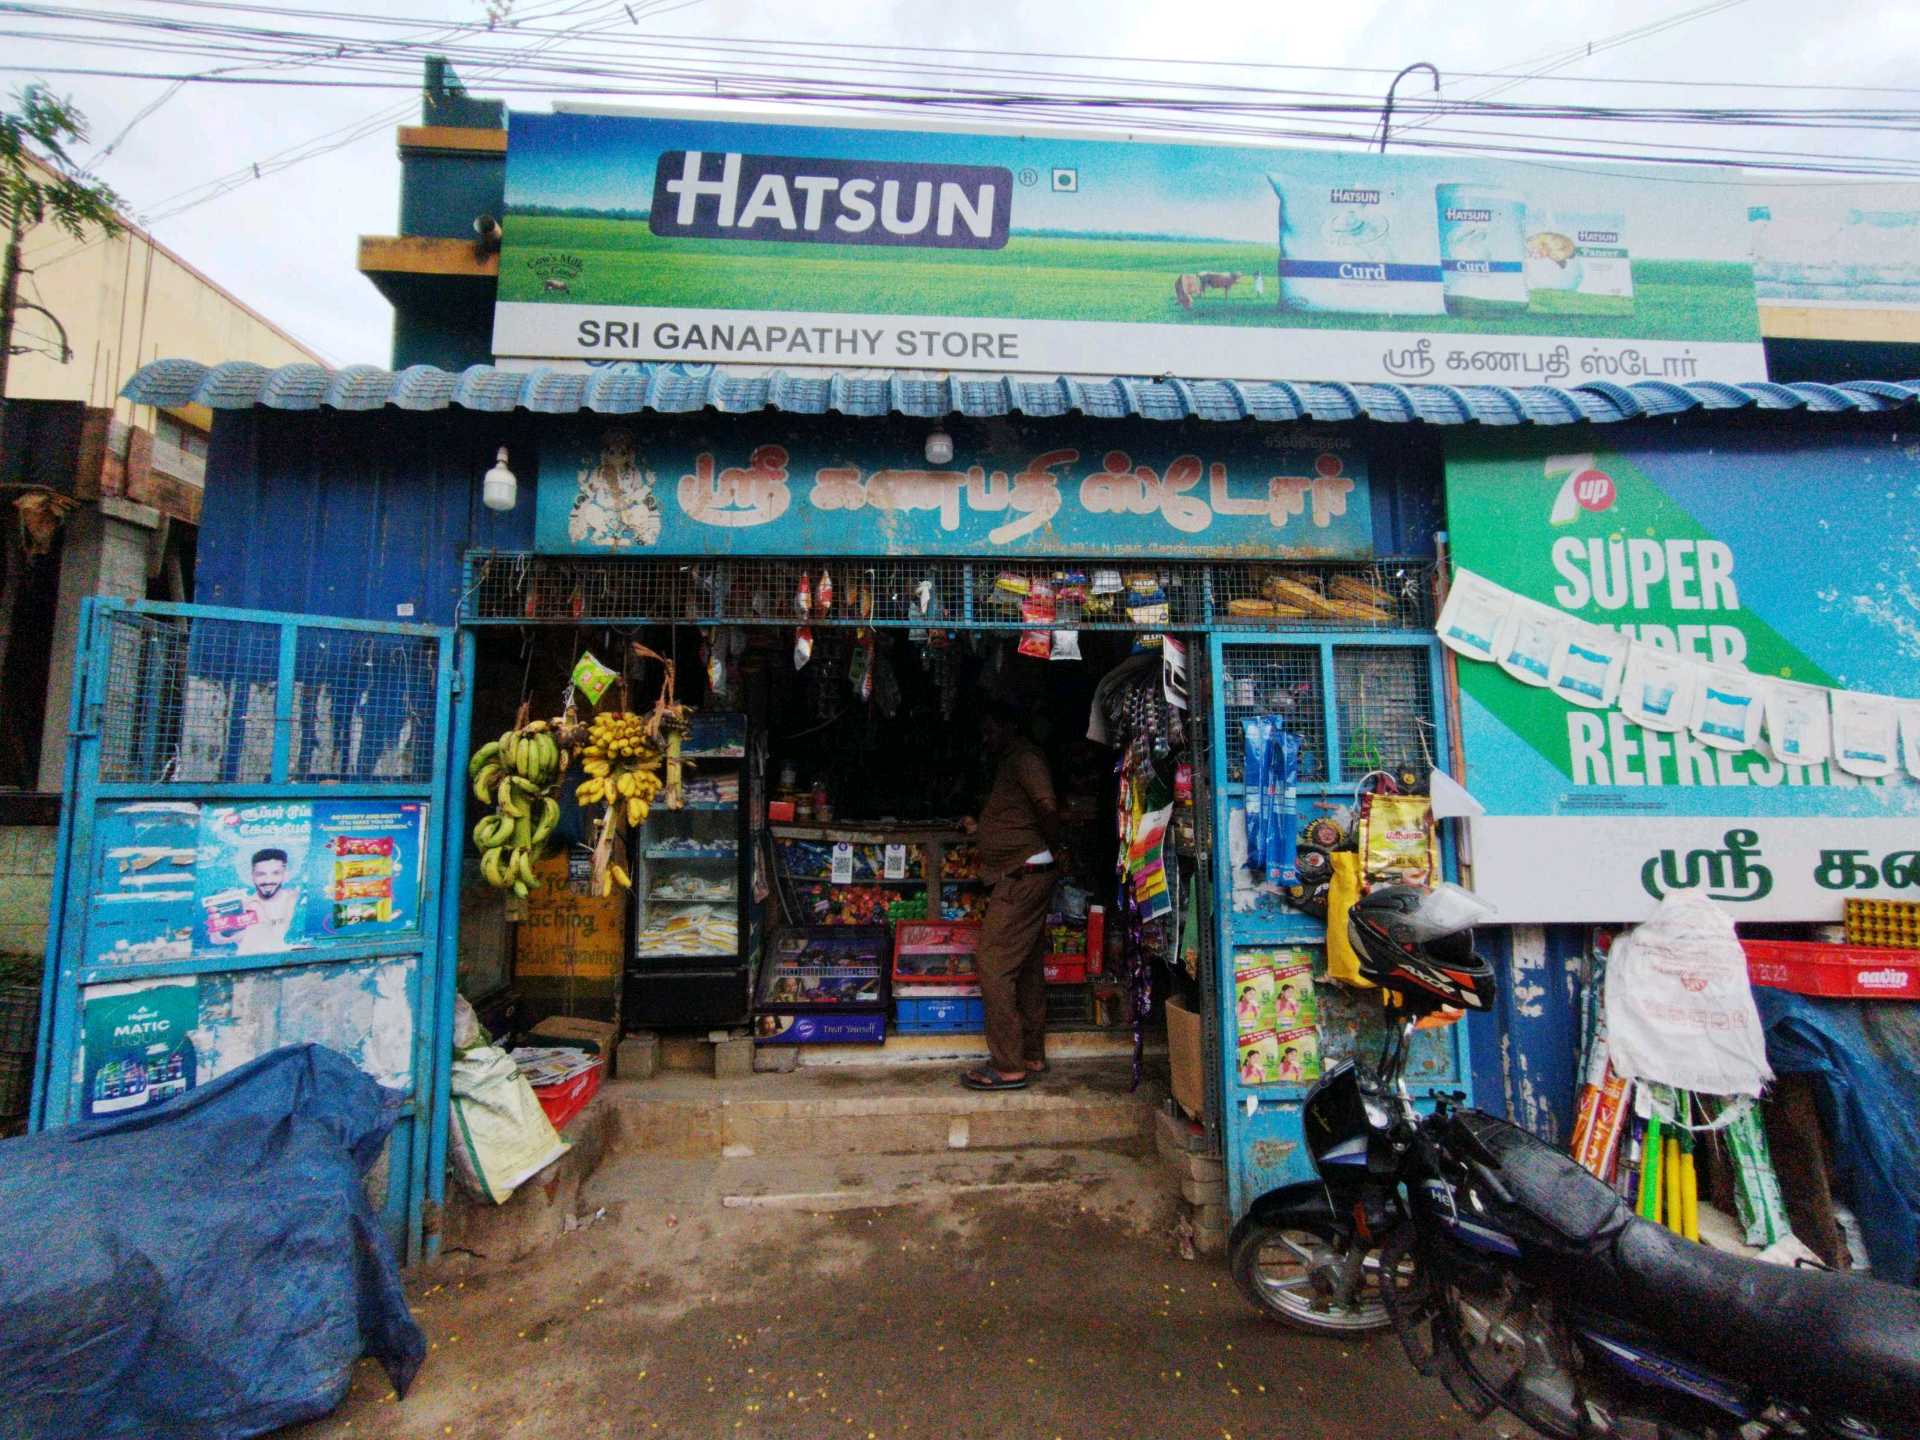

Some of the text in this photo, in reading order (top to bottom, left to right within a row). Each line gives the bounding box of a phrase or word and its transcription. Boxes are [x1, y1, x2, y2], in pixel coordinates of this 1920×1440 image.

[666, 151, 995, 238] HATSUN
[1332, 190, 1377, 203] HATSUN
[1447, 208, 1490, 221] HATSUN
[1339, 263, 1386, 280] Curd
[1456, 261, 1490, 272] Curd
[577, 320, 1019, 359] SRI GANAPATHY STORE
[1446, 345, 1570, 383] கணபதி
[1580, 347, 1698, 378] ஸ்டோர்
[809, 449, 1080, 545] கணபதி
[1552, 538, 1740, 611] SUPER
[114, 1020, 171, 1037] MATIC
